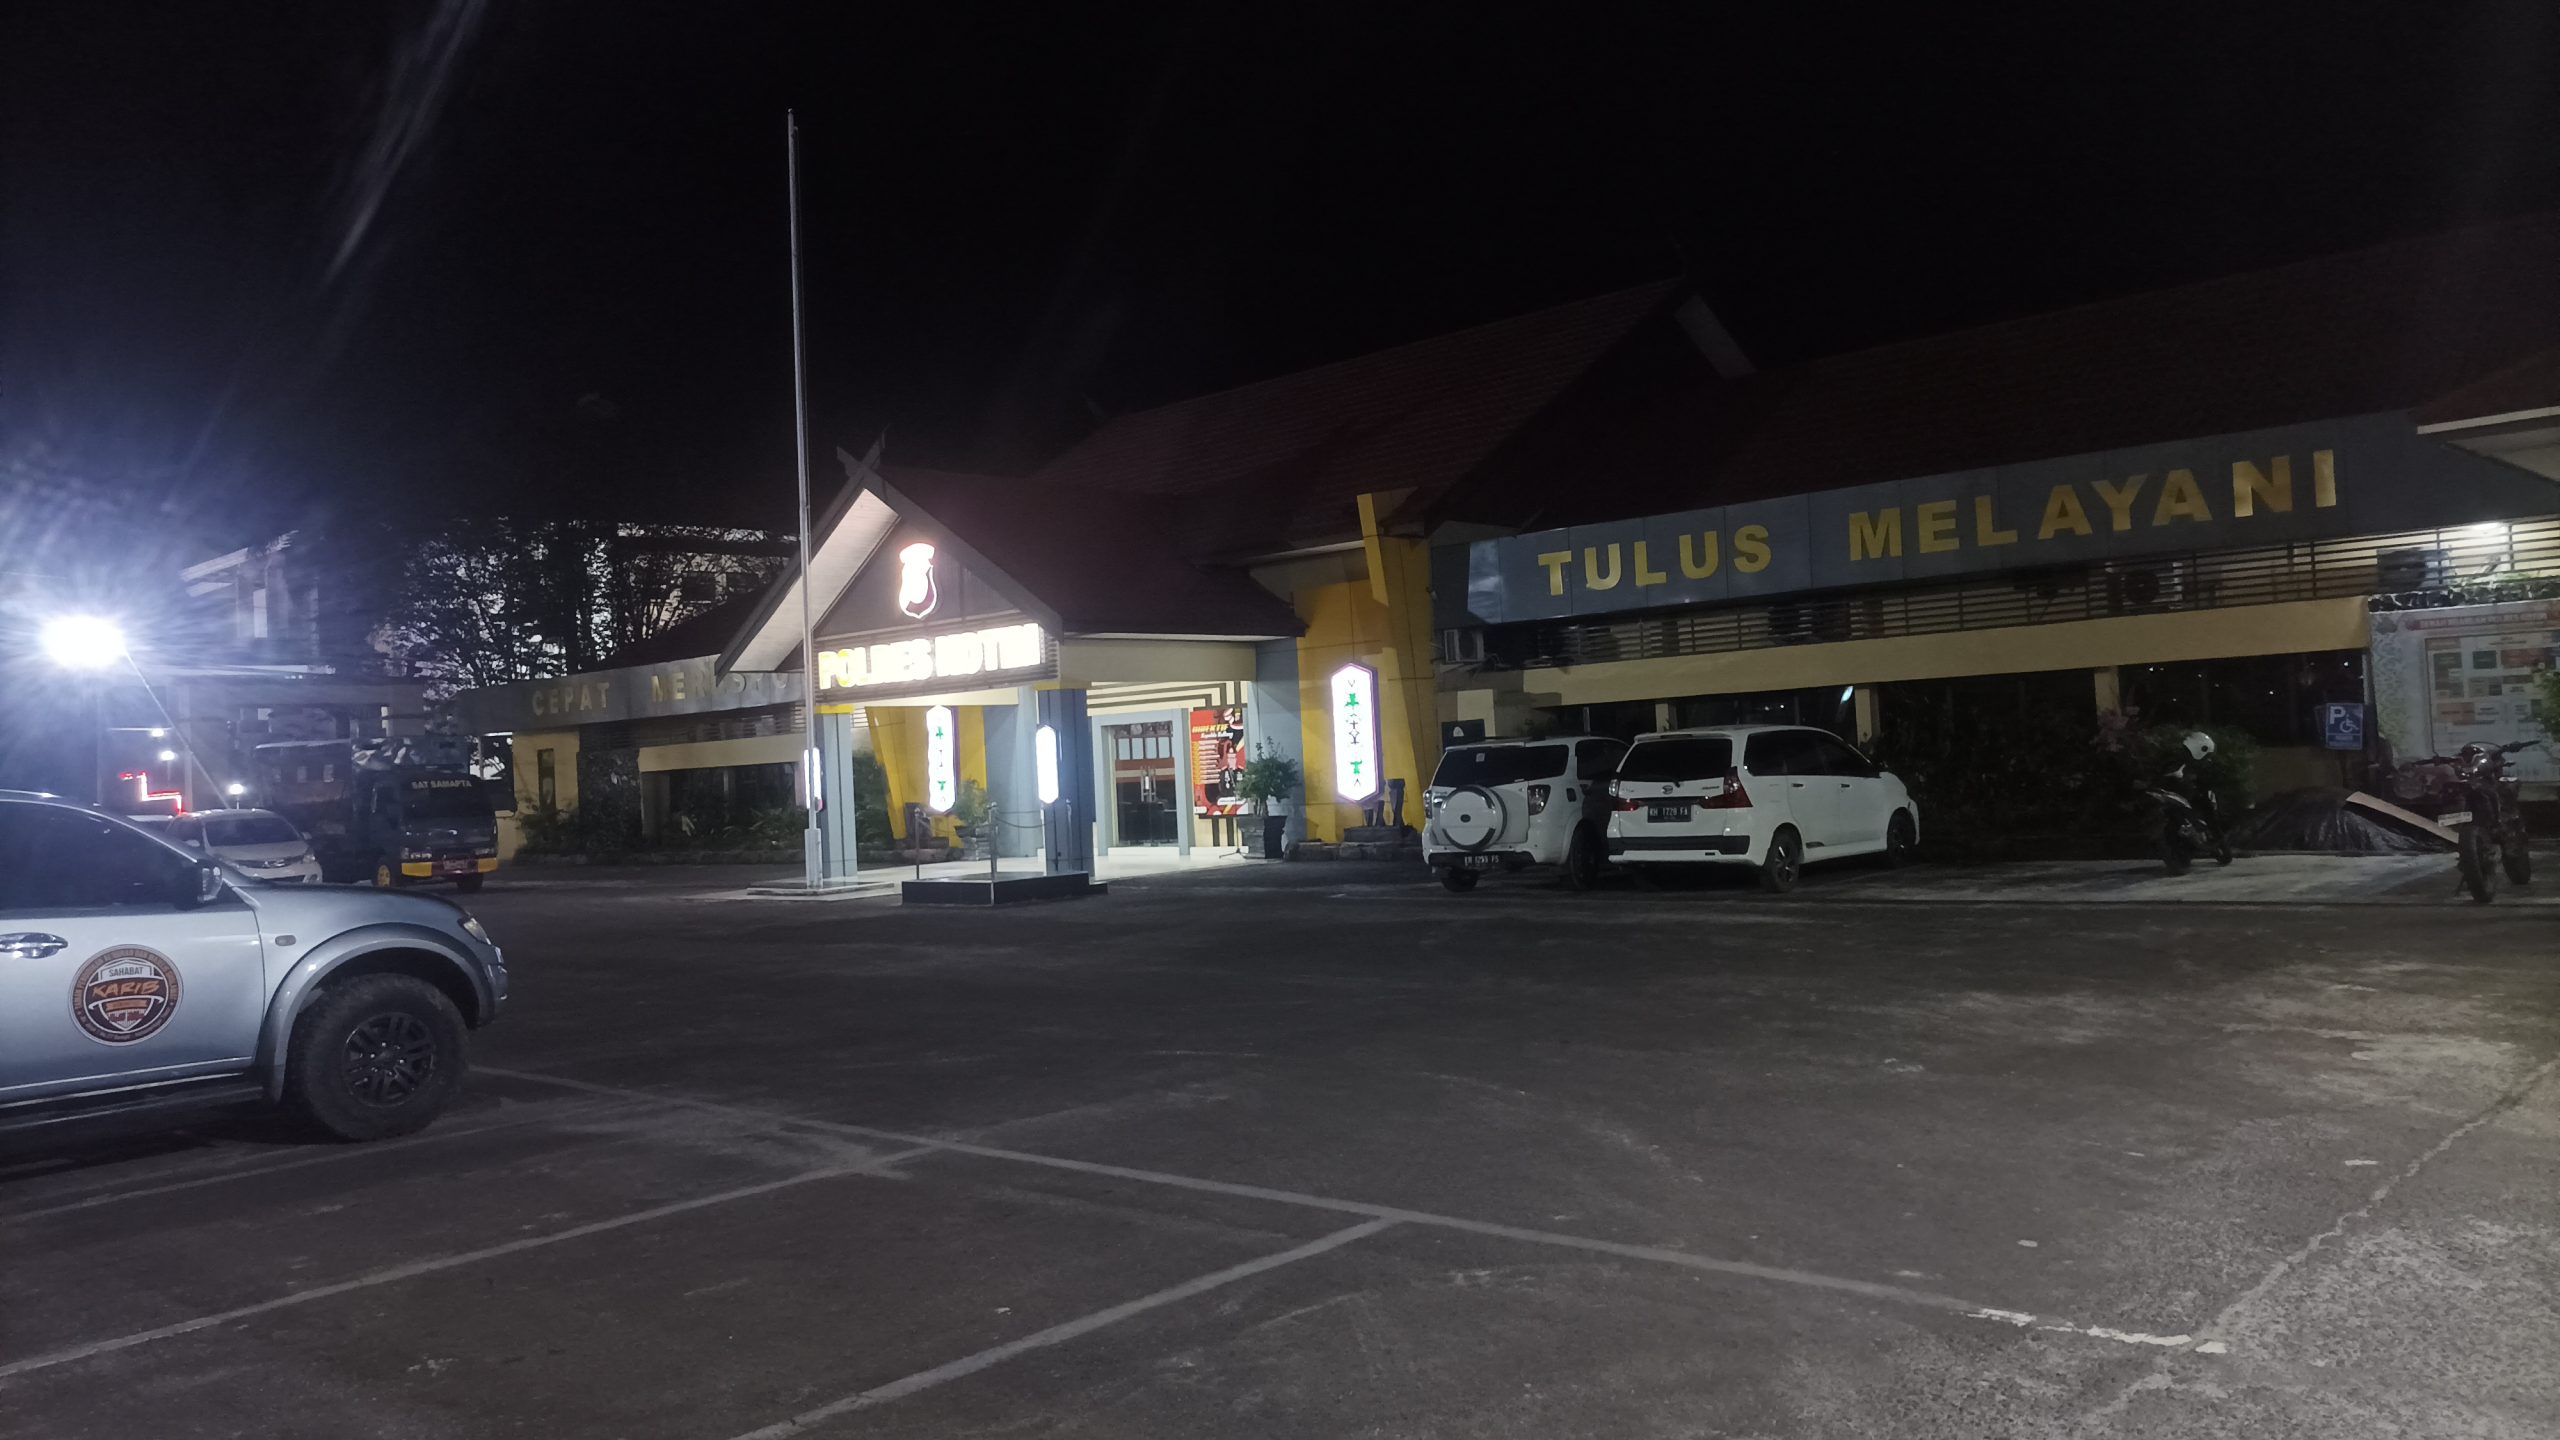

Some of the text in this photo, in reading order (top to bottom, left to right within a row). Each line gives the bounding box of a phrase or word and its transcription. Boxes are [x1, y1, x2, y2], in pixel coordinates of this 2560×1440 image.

[1537, 449, 2337, 596] TULUS MELAYANI
[532, 682, 610, 716] CEPAT
[2329, 706, 2346, 724] P
[411, 781, 428, 790] SAT
[108, 966, 144, 978] SAHABAT
[92, 980, 160, 998] KARIB
